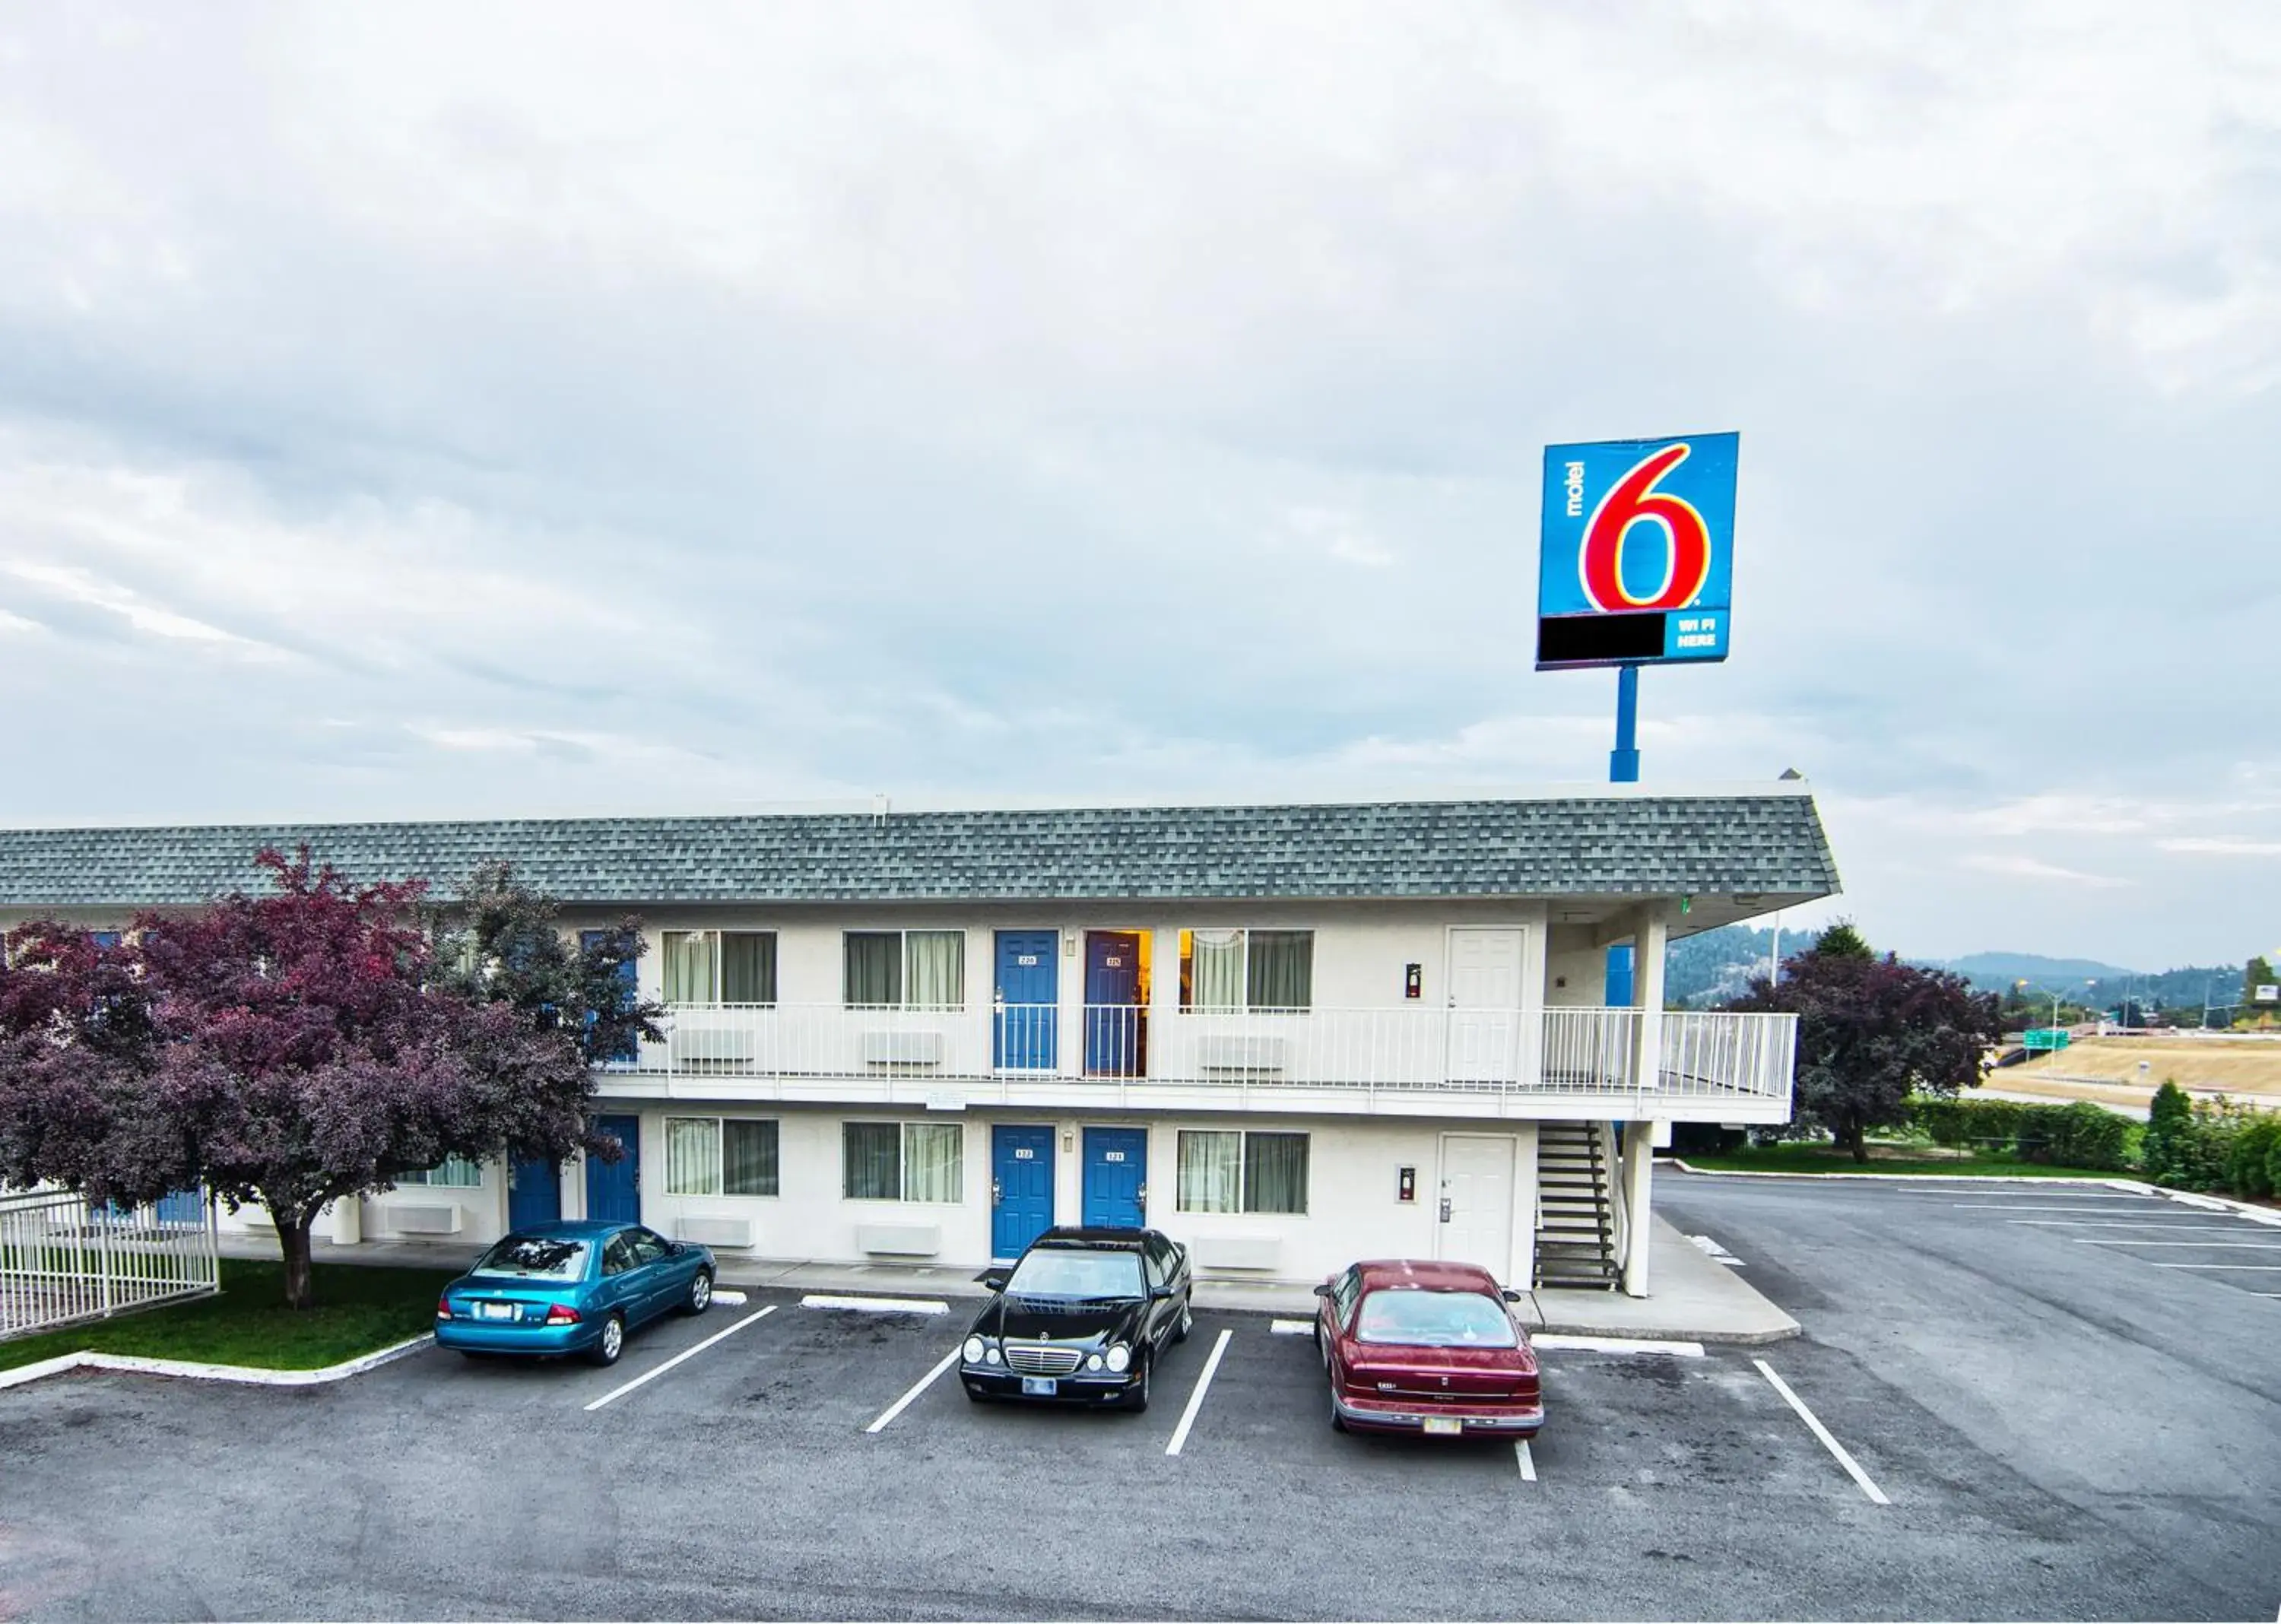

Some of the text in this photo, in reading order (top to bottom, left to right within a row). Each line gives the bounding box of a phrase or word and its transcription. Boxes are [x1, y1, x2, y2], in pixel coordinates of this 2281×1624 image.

[1564, 462, 1585, 516] motel
[1578, 442, 1711, 614] 6
[1677, 634, 1716, 648] HERE
